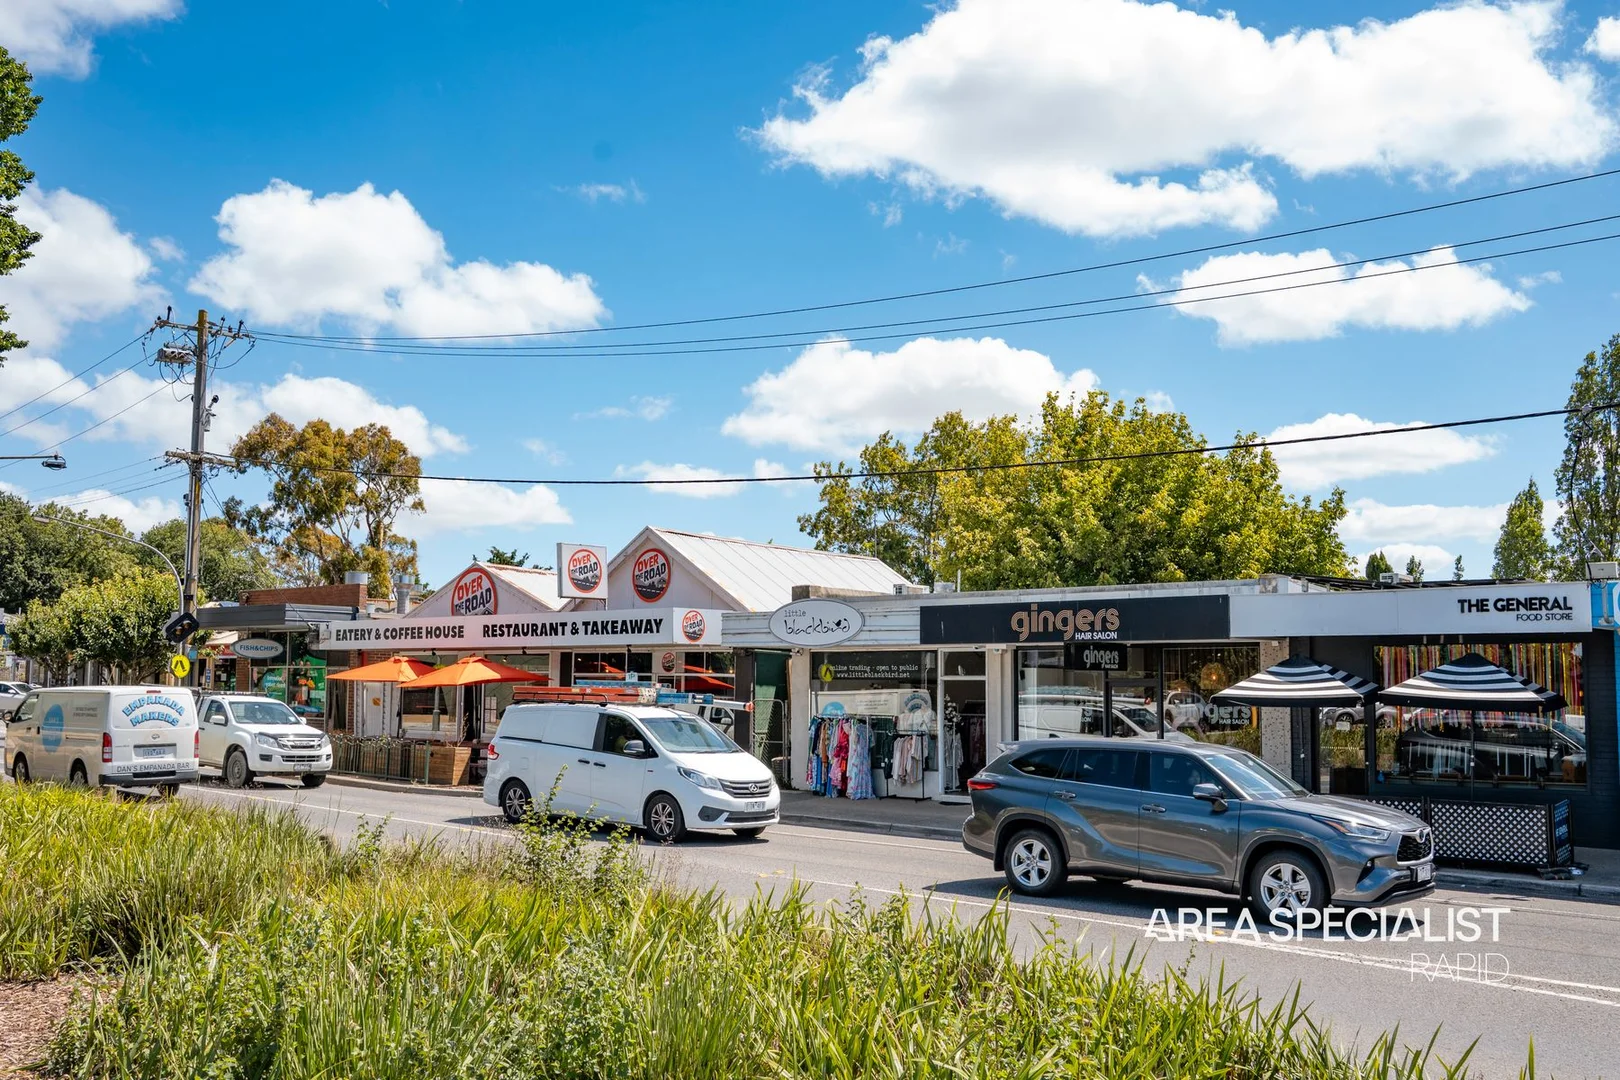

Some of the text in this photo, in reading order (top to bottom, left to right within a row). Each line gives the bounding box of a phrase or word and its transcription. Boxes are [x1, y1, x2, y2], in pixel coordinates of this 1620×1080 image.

[572, 554, 591, 568] OVER
[637, 554, 659, 572] OVER
[578, 562, 598, 577] ROAD
[643, 562, 666, 582] ROAD
[457, 575, 483, 601] OVER
[455, 587, 492, 614] THE ROAD
[1458, 597, 1573, 613] THE GENERAL
[685, 614, 698, 624] OVER
[784, 609, 807, 618] little
[1516, 612, 1573, 621] FOOD STORE
[482, 618, 664, 638] RESTAURANT & TAKEAWAY
[689, 619, 702, 629] ROAD
[784, 617, 851, 634] blackbird
[1010, 603, 1120, 641] gingers
[335, 625, 464, 641] EATERY & COFFEE HOUSE
[1075, 631, 1117, 640] HAIR SALON
[240, 644, 279, 652] FISH&CHIPS
[1083, 645, 1119, 669] gingers
[849, 664, 871, 673] trading
[899, 664, 918, 672] public
[122, 695, 185, 717] EMPANADA
[129, 711, 180, 727] MAKERS
[116, 765, 138, 773] DAN'S
[140, 763, 176, 771] EMPANADA
